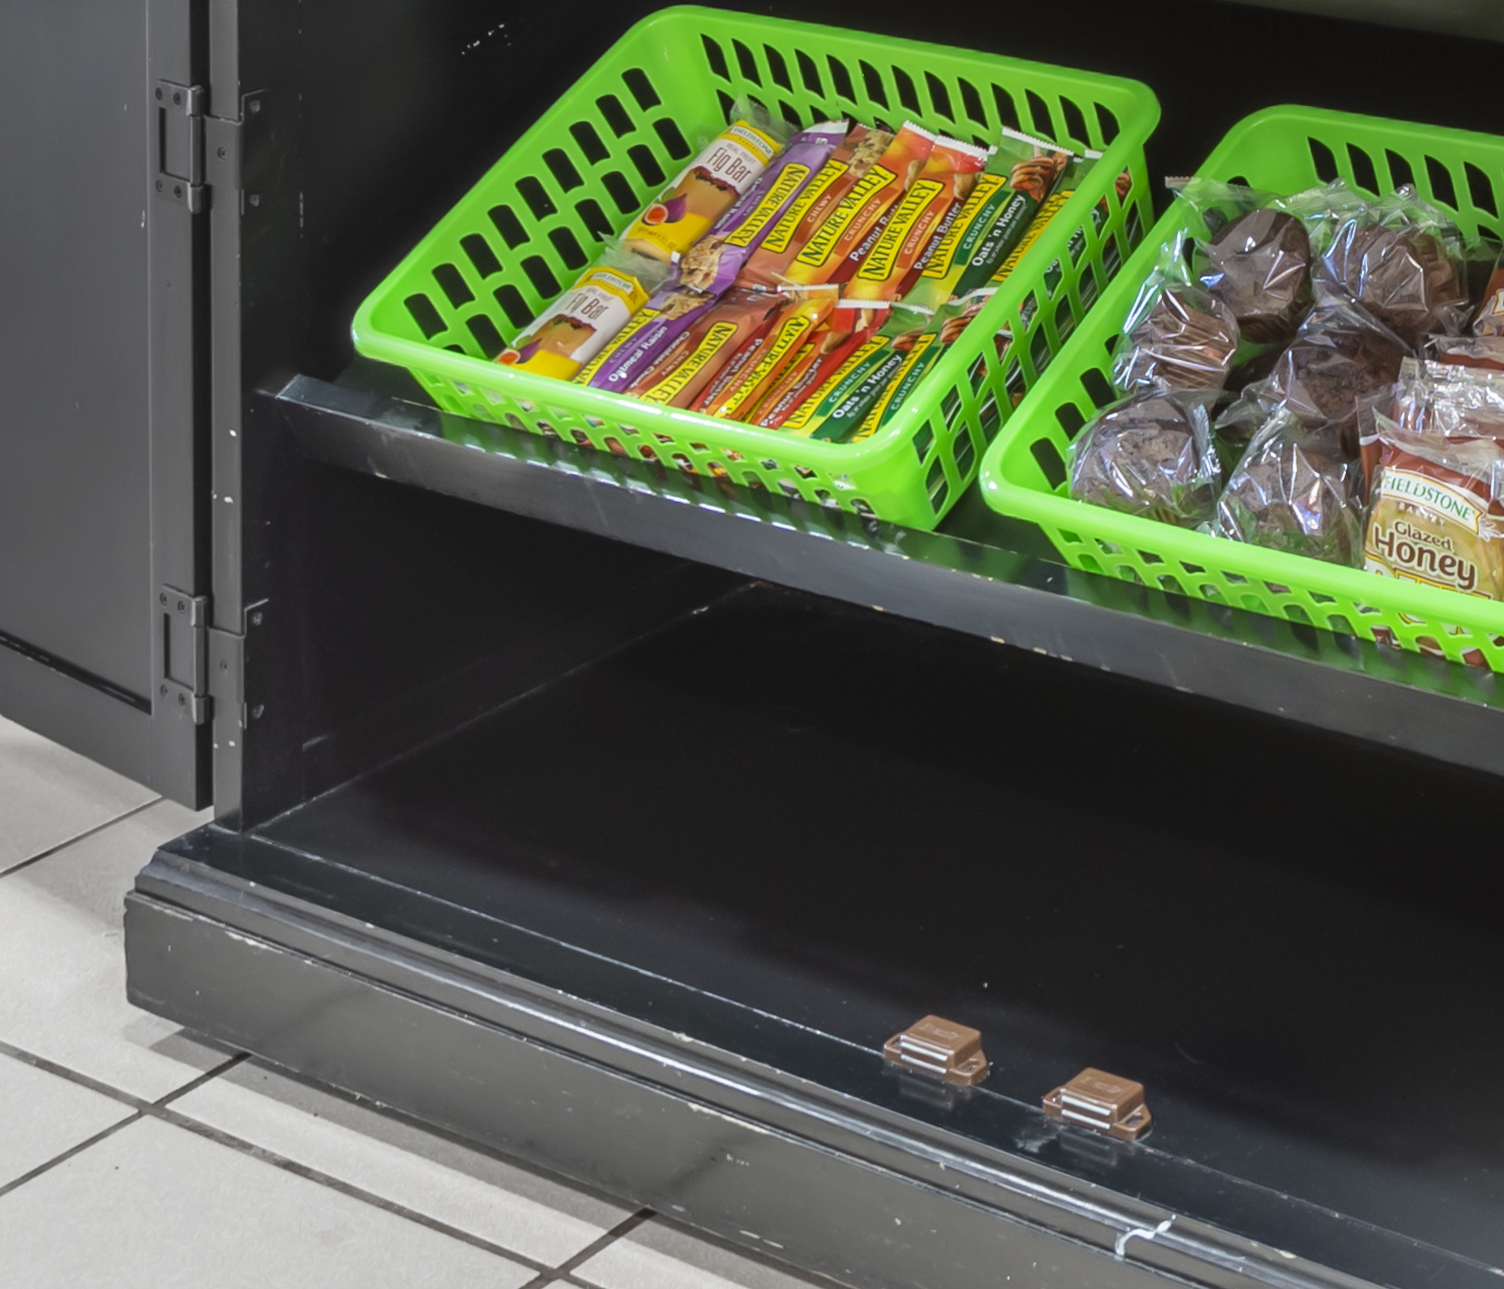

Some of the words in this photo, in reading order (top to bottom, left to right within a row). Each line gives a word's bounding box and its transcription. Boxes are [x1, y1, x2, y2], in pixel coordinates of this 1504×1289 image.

[706, 146, 731, 173] Fig
[724, 156, 752, 184] Bar
[765, 165, 805, 211] NATURE
[731, 205, 772, 246] VALLEY
[765, 205, 806, 249] NATURE
[801, 162, 844, 210] VALLEY
[802, 211, 848, 262] NATURE
[840, 165, 887, 215] VALLEY
[807, 194, 833, 223] CHEWY
[844, 197, 882, 242] CRUNCHY
[863, 221, 903, 277] NATURE
[899, 180, 937, 226] VALLEY
[926, 220, 963, 274] NATURE
[958, 175, 1001, 228] VALLEY
[963, 203, 995, 250] CRUNCHY
[849, 226, 883, 262] Peanut
[903, 209, 935, 256] CRUNCHY
[913, 233, 942, 270] Peanut
[937, 202, 962, 235] Butter
[972, 237, 995, 267] Oats
[996, 194, 1026, 228] Honey
[581, 297, 610, 320] Bar
[691, 324, 731, 368] NATURE
[829, 361, 871, 404] CRUNCHY
[832, 396, 860, 419] Oats
[868, 354, 902, 385] Honey
[891, 362, 925, 411] CRUNCHY
[1383, 475, 1473, 521] FIELDSTONE
[1374, 525, 1476, 590] Honey
[1395, 521, 1453, 551] Glazed
